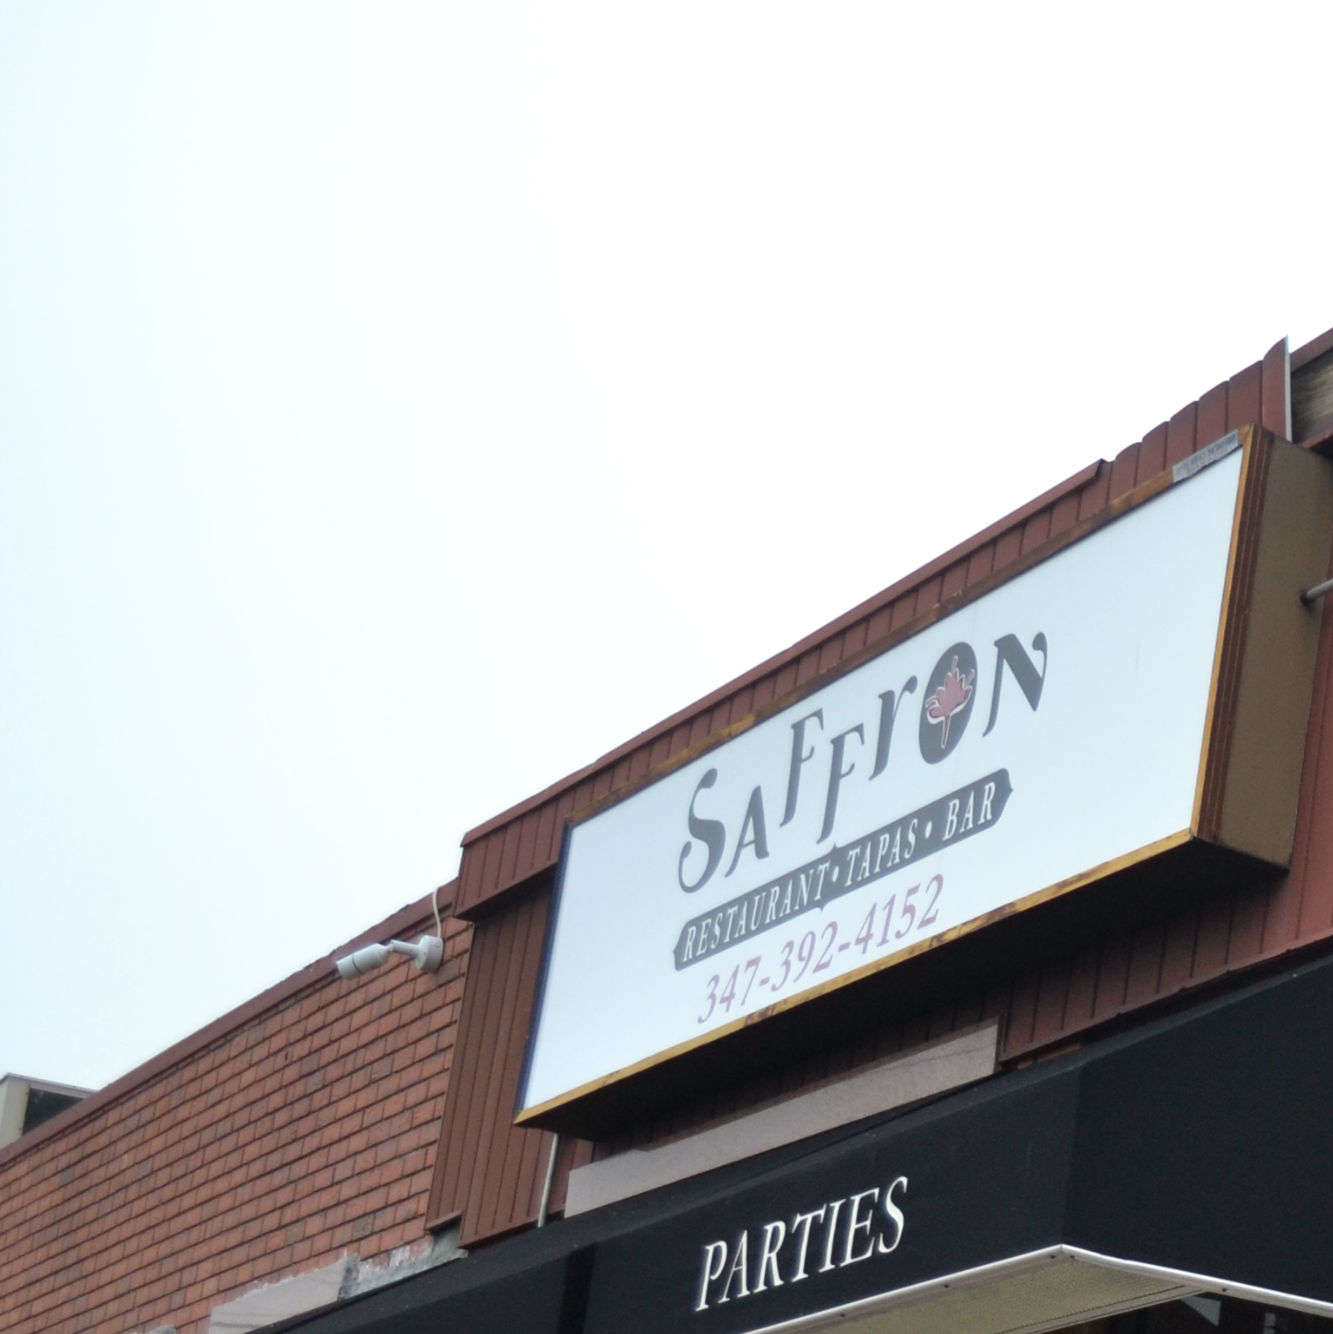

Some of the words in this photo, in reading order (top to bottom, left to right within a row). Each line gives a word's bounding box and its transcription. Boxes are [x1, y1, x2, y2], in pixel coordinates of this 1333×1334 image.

[681, 863, 832, 963] RESTAURANT
[842, 827, 919, 887] TAPAS
[942, 780, 997, 840] BAR
[696, 874, 945, 1024] 347-392-4152
[695, 1175, 909, 1312] PARTIES
